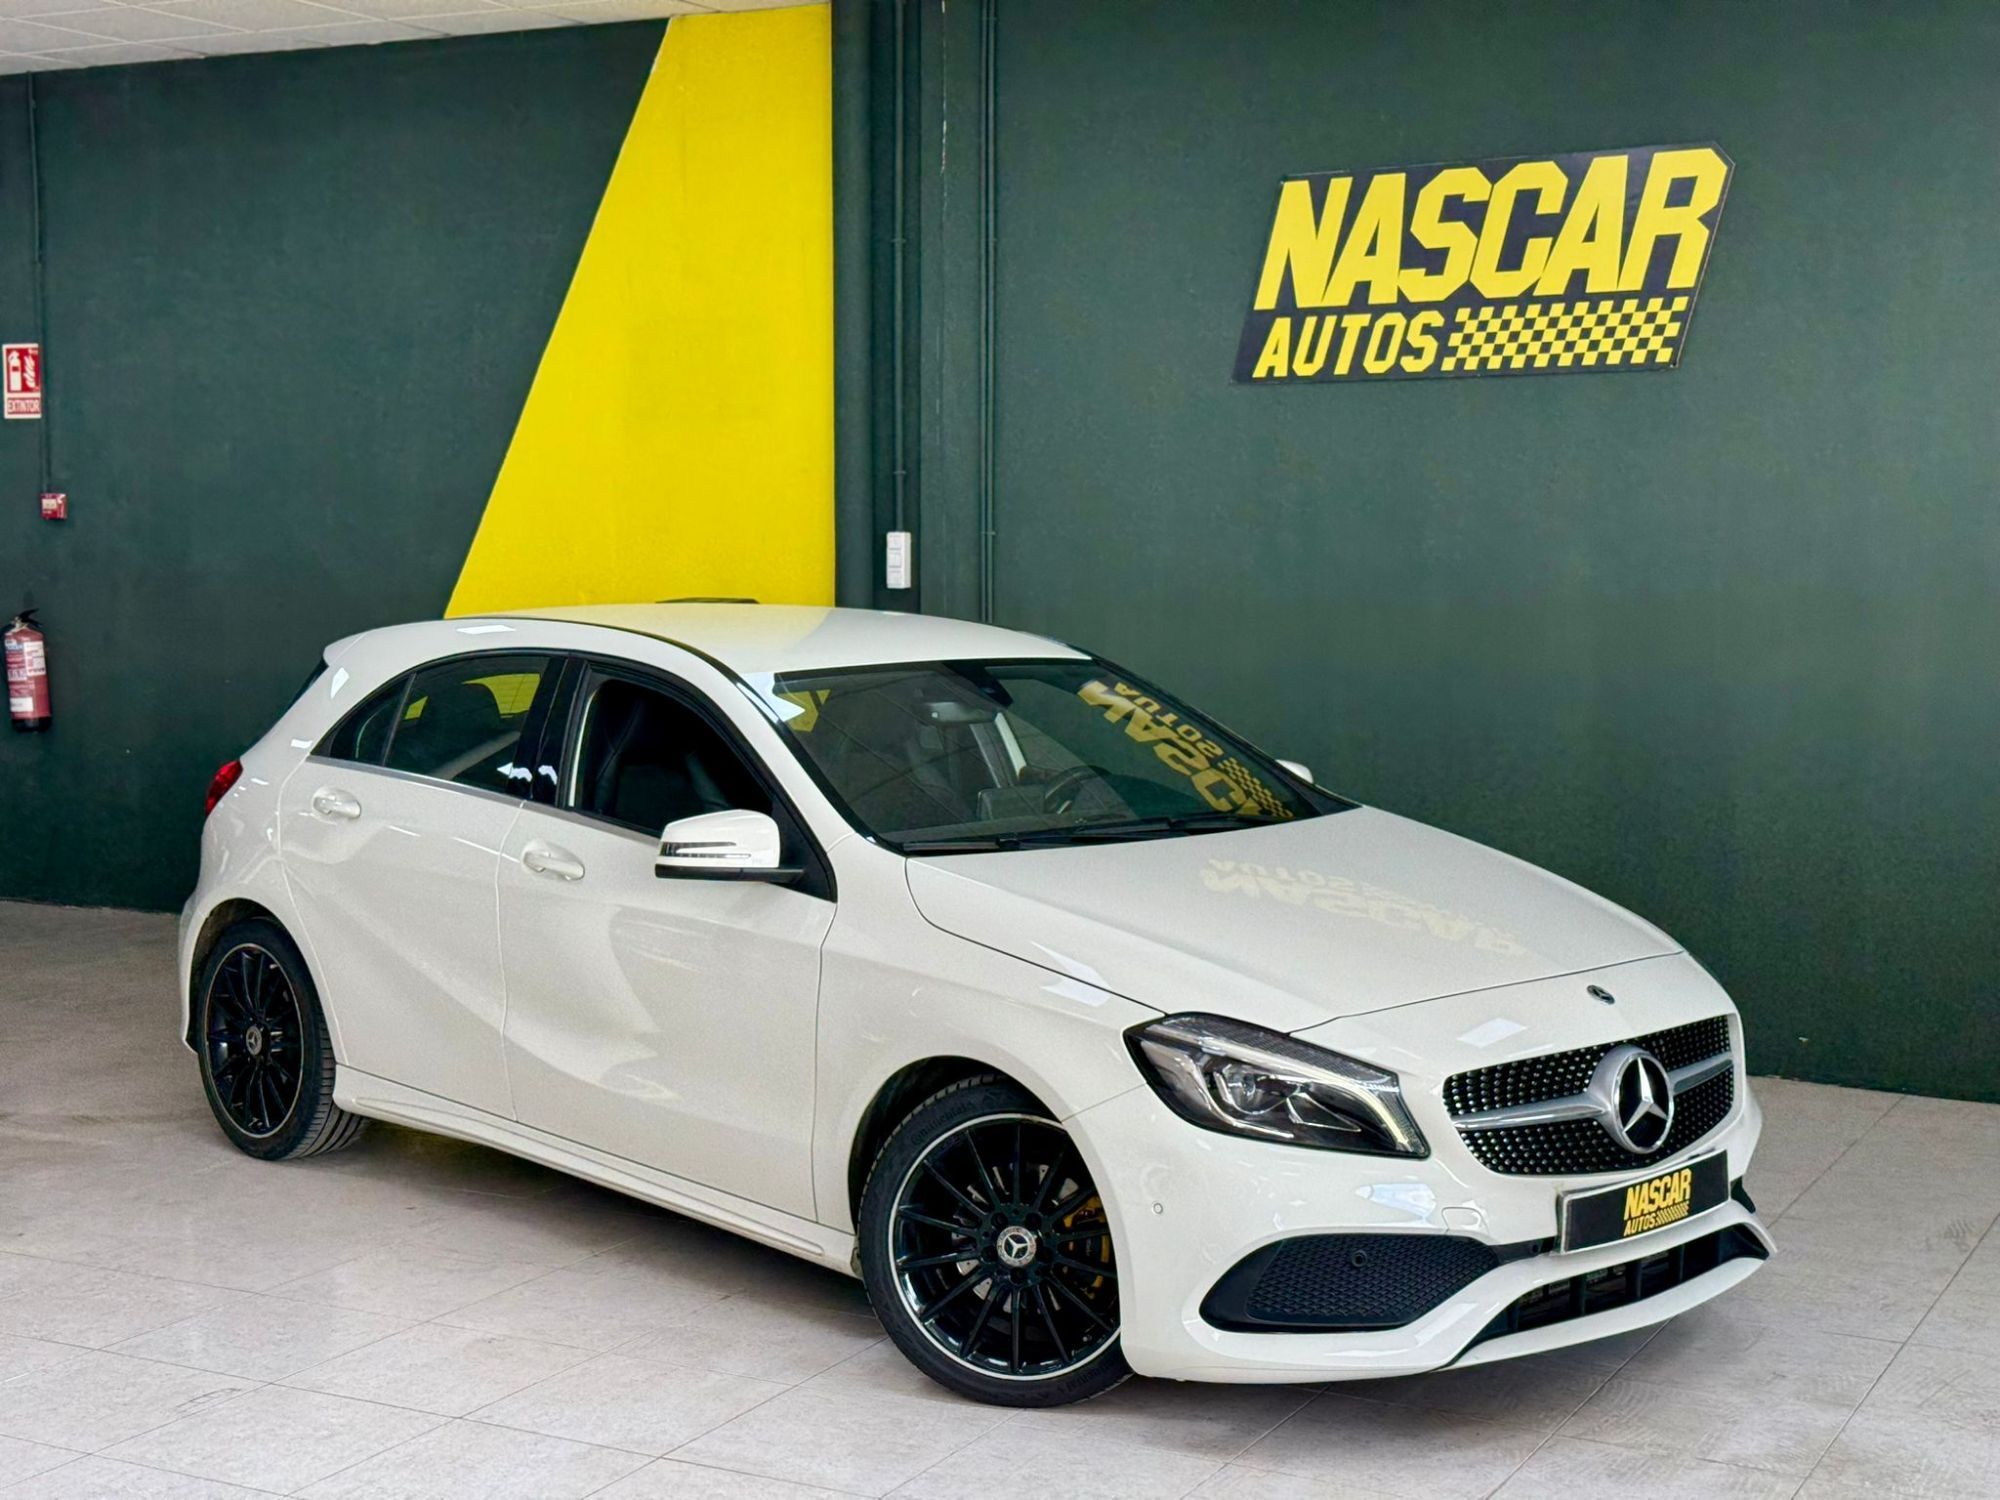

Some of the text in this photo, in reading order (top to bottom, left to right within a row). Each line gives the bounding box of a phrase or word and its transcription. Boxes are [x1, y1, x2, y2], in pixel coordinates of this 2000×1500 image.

[1254, 148, 1728, 310] NASCAR
[1253, 311, 1445, 378] AUTOS
[7, 399, 40, 413] EXTINTOR
[1624, 1169, 1692, 1220] NASCAR
[1624, 1213, 1656, 1235] AUTOS
